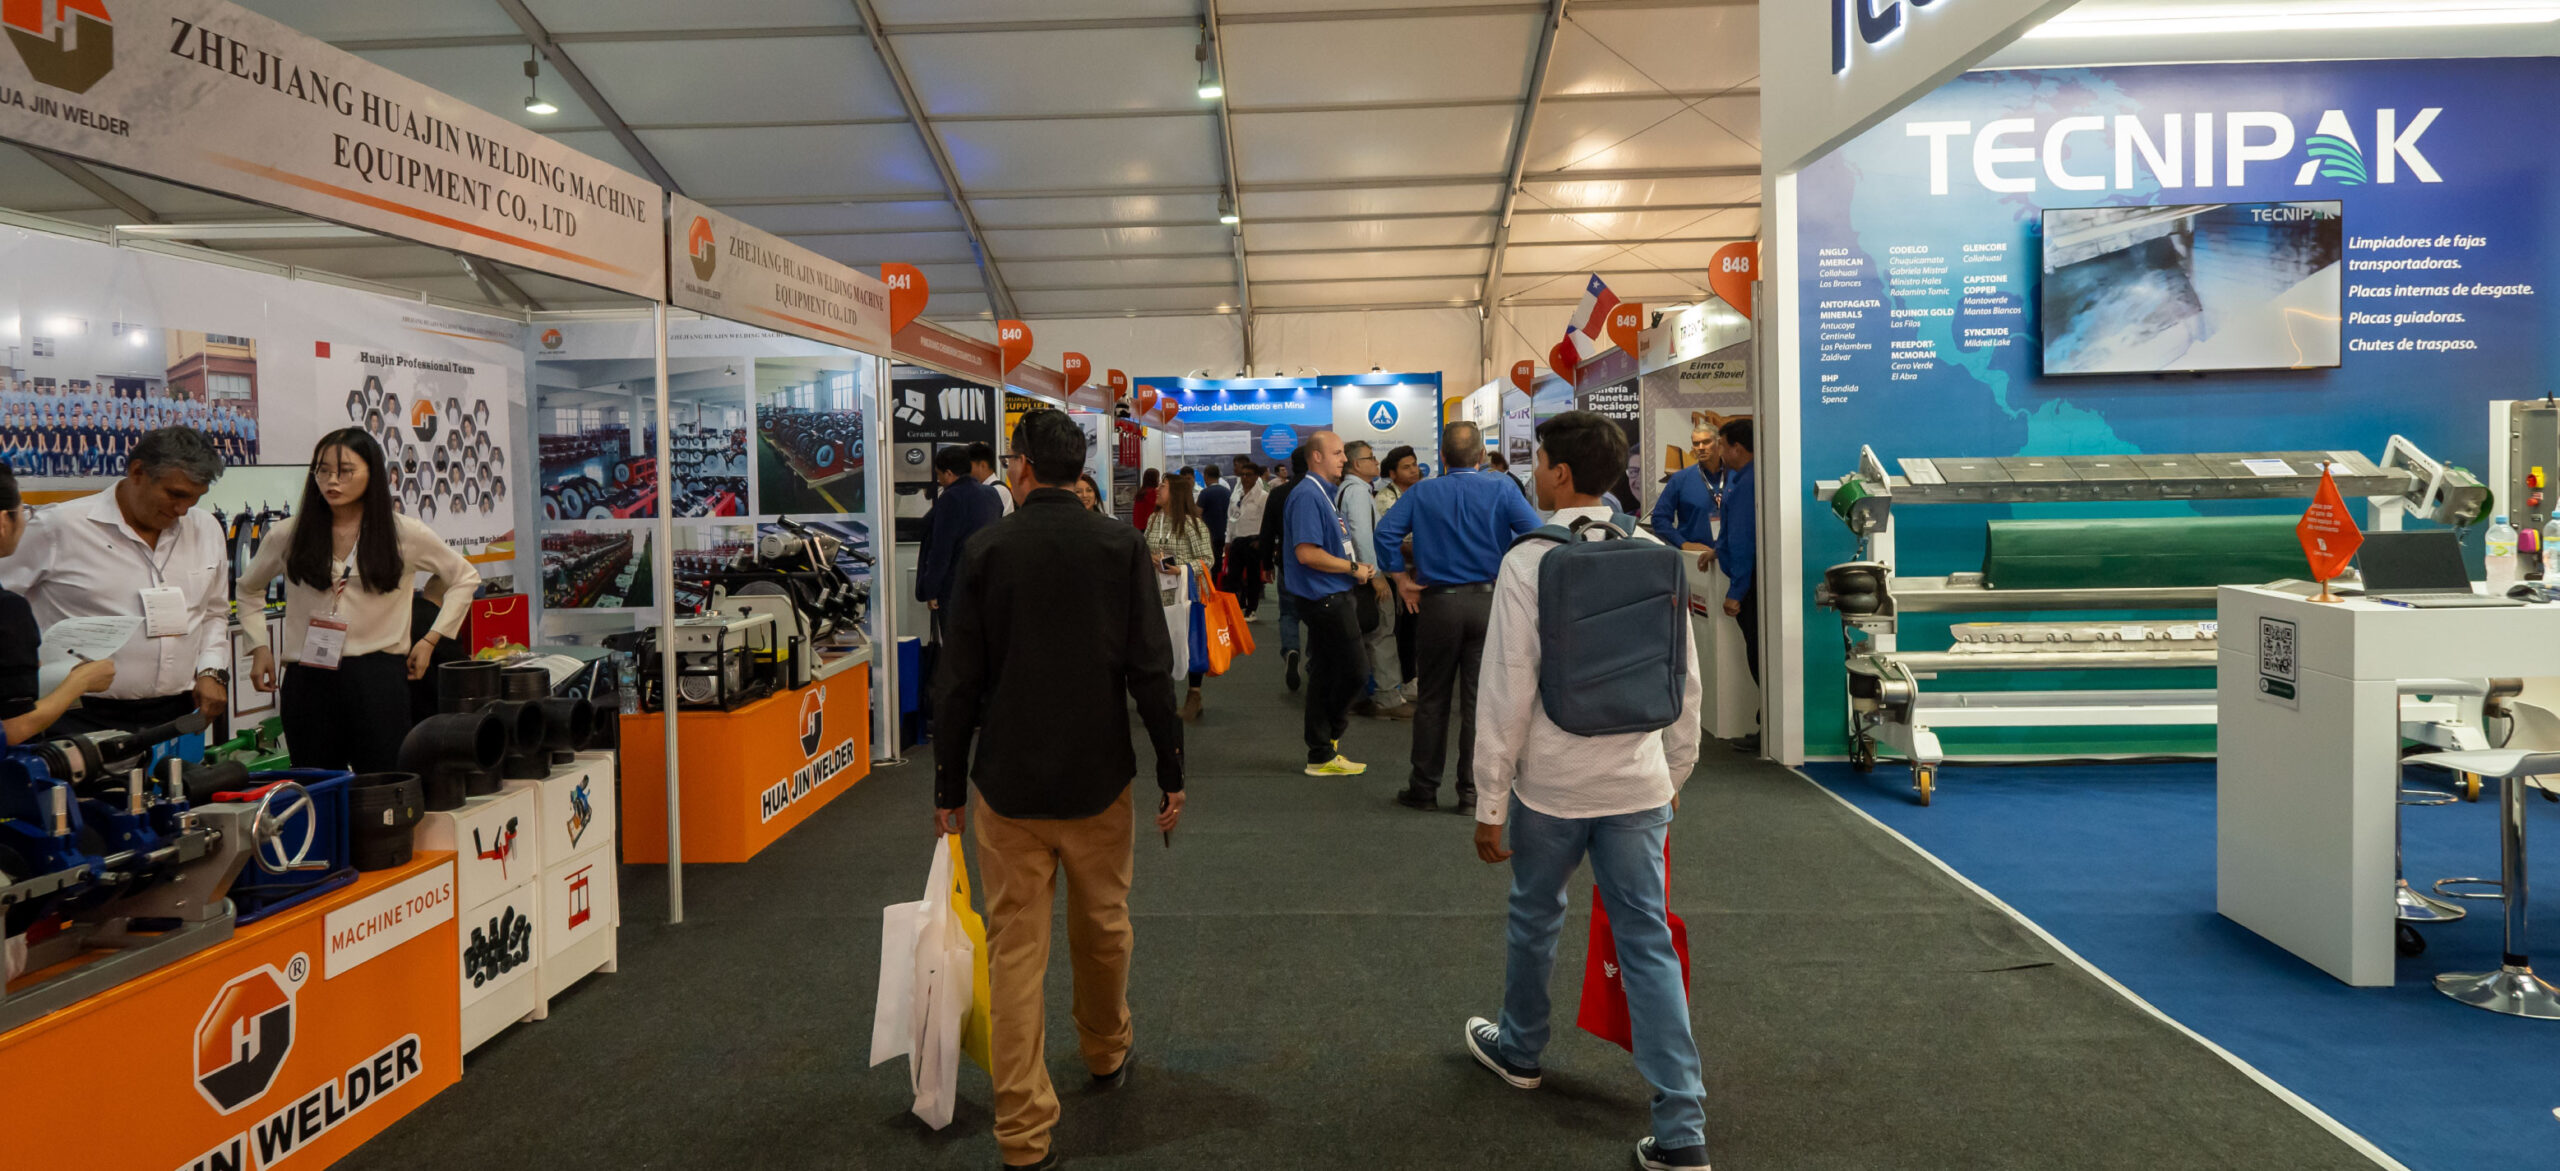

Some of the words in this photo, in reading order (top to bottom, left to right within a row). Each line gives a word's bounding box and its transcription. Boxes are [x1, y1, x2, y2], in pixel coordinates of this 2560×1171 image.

[29, 96, 58, 118] JIN
[62, 104, 129, 137] WELDER
[170, 17, 353, 116] ZHEJIANG
[361, 90, 460, 154] HUAJIN
[466, 131, 565, 192] WELDING
[569, 172, 646, 223] MACHINE
[1906, 107, 2443, 195] TECNIPAK
[332, 133, 492, 211] EQUIPMENT
[496, 189, 537, 231] CO.,
[542, 203, 577, 237] LTD
[1962, 243, 2007, 252] GLENCORE
[2349, 236, 2431, 251] Limpiadores
[2434, 235, 2450, 247] de
[2454, 235, 2486, 249] fajas
[1820, 248, 1848, 256] ANGLO
[1890, 245, 1928, 254] CODELCO
[1820, 258, 1863, 266] AMERICAN
[1890, 257, 1944, 265] Chuquicamata
[1963, 254, 2002, 262] Collahuasi
[1722, 256, 1749, 272] 848
[2349, 257, 2461, 272] transportadoras.
[730, 236, 781, 272] ZHEJIANG
[783, 257, 814, 285] HUAJIN
[817, 271, 853, 299] WELDING
[853, 285, 884, 311] MACHINE
[1820, 269, 1858, 277] Collahuasi
[1890, 267, 1920, 275] Gabriela
[888, 274, 910, 289] 841
[1963, 275, 2008, 283] CAPSTONE
[1820, 280, 1831, 288] Los
[1964, 286, 1996, 294] COPPER
[2349, 285, 2391, 297] Placas
[2394, 285, 2449, 297] internas
[2452, 283, 2469, 296] de
[2471, 283, 2534, 298] desgaste.
[775, 284, 826, 316] EQUIPMENT
[844, 308, 857, 325] LTD
[1820, 300, 1880, 308] ANTOFAGASTA
[1964, 296, 2008, 304] Mantoverde
[1821, 311, 1862, 319] MINERALS
[1891, 309, 1928, 318] EQUINOX
[1930, 308, 1954, 316] GOLD
[1617, 315, 1637, 326] 849
[2349, 312, 2391, 324] Placas
[2394, 310, 2465, 326] guiadoras.
[1821, 322, 1855, 330] Antucoya
[1002, 328, 1022, 339] 840
[1821, 332, 1855, 340] Centinela
[1964, 328, 2009, 336] SYNCRUDE
[1821, 343, 1833, 351] Los
[1834, 342, 1872, 350] Pelambres
[1891, 340, 1935, 349] FREEPORT-
[1964, 339, 1992, 347] Mildred
[2349, 338, 2394, 351] Chutes
[2397, 338, 2413, 350] de
[2416, 339, 2477, 352] traspaso.
[1891, 351, 1936, 359] MCMORAN
[360, 352, 394, 367] Huajin
[396, 356, 451, 372] Professional
[452, 363, 475, 374] Team
[1066, 359, 1081, 368] 839
[1690, 362, 1724, 370] Eimco
[1891, 362, 1911, 370] Cerro
[1913, 361, 1933, 369] Verde
[1680, 370, 1711, 379] Rocker
[1713, 370, 1744, 379] Shovel
[1900, 372, 1918, 380] Abra
[1822, 396, 1847, 404] Spence
[1178, 403, 1209, 412] Servicio
[1211, 403, 1222, 411] de
[1224, 402, 1270, 411] Laboratorio
[1589, 402, 1639, 412] Decálogo
[449, 538, 478, 546] Welding
[762, 781, 789, 819] HUA
[792, 767, 810, 799] JIN
[813, 741, 854, 785] WELDER
[332, 905, 403, 954] MACHINE
[406, 883, 450, 919] TOOLS
[256, 1038, 418, 1165] WELDER
